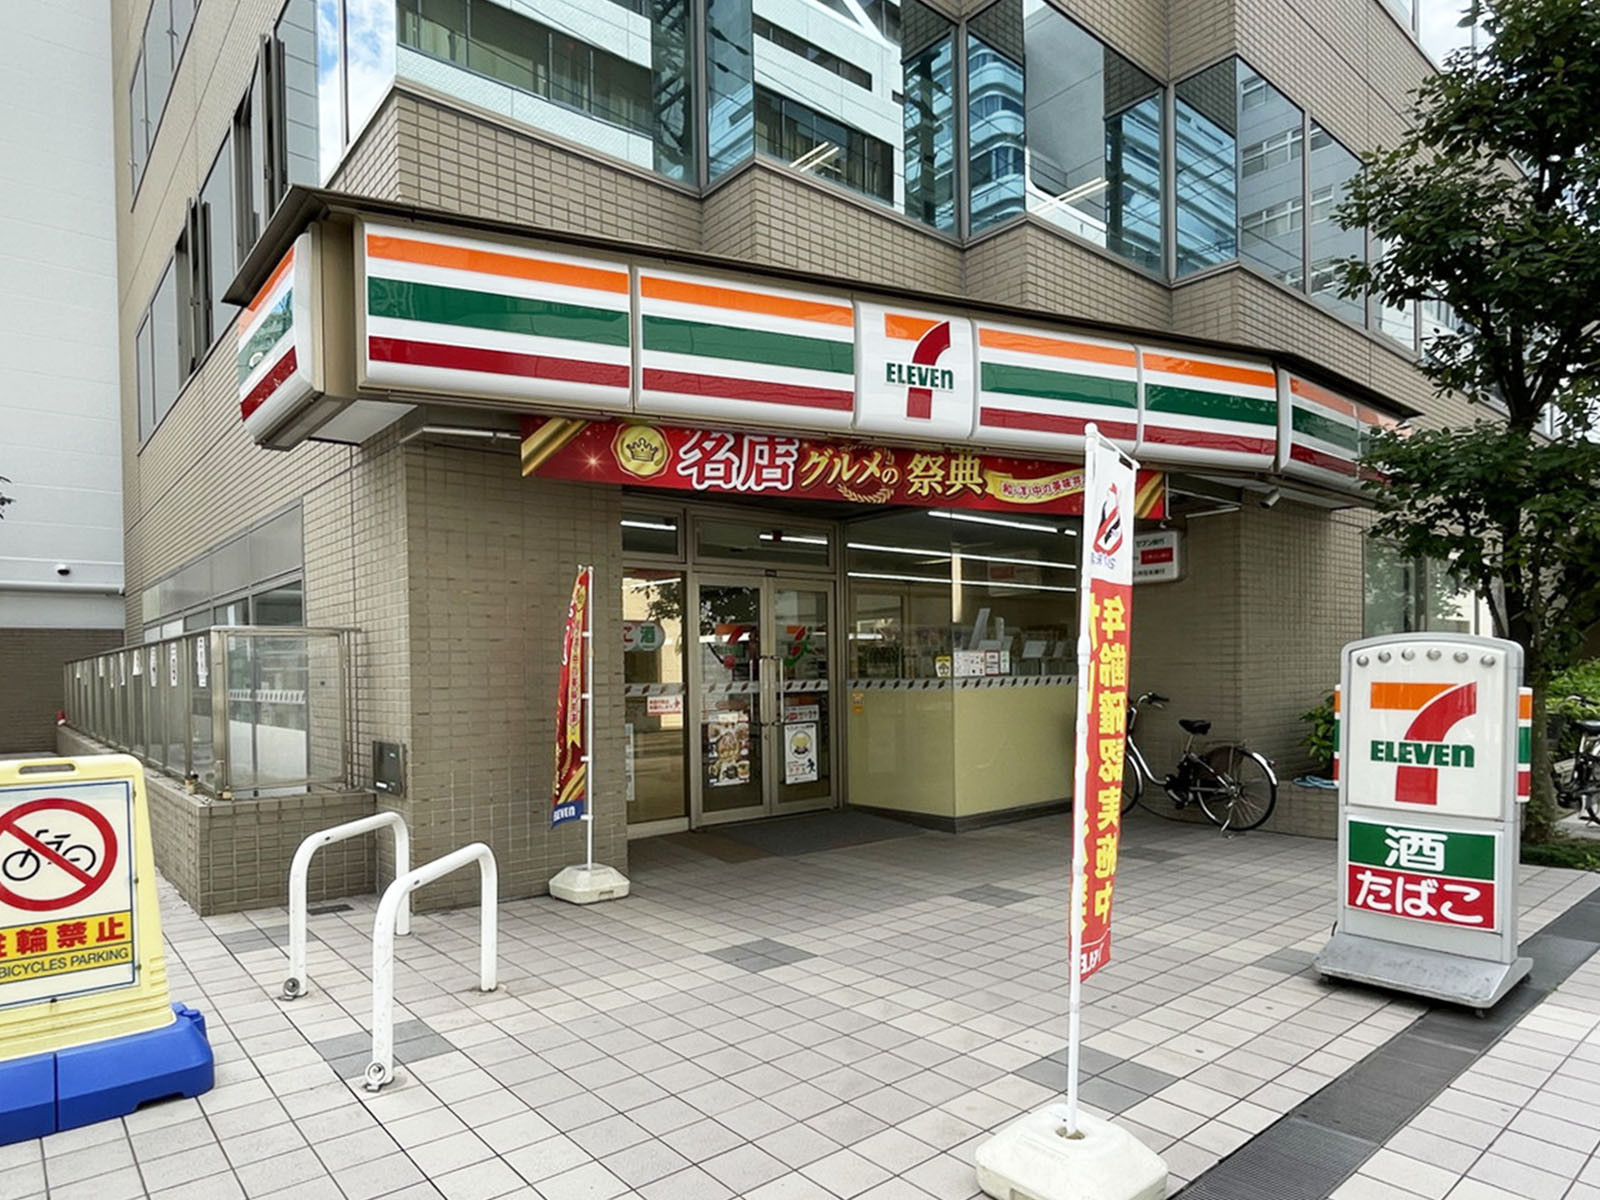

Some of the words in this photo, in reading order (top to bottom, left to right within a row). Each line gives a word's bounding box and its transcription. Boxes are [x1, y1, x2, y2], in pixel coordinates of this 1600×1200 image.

[884, 313, 951, 420] 7
[1370, 681, 1477, 806] 7
[1384, 827, 1448, 873] 酒
[1355, 870, 1485, 925] たばこ
[70, 947, 129, 967] PARKING
